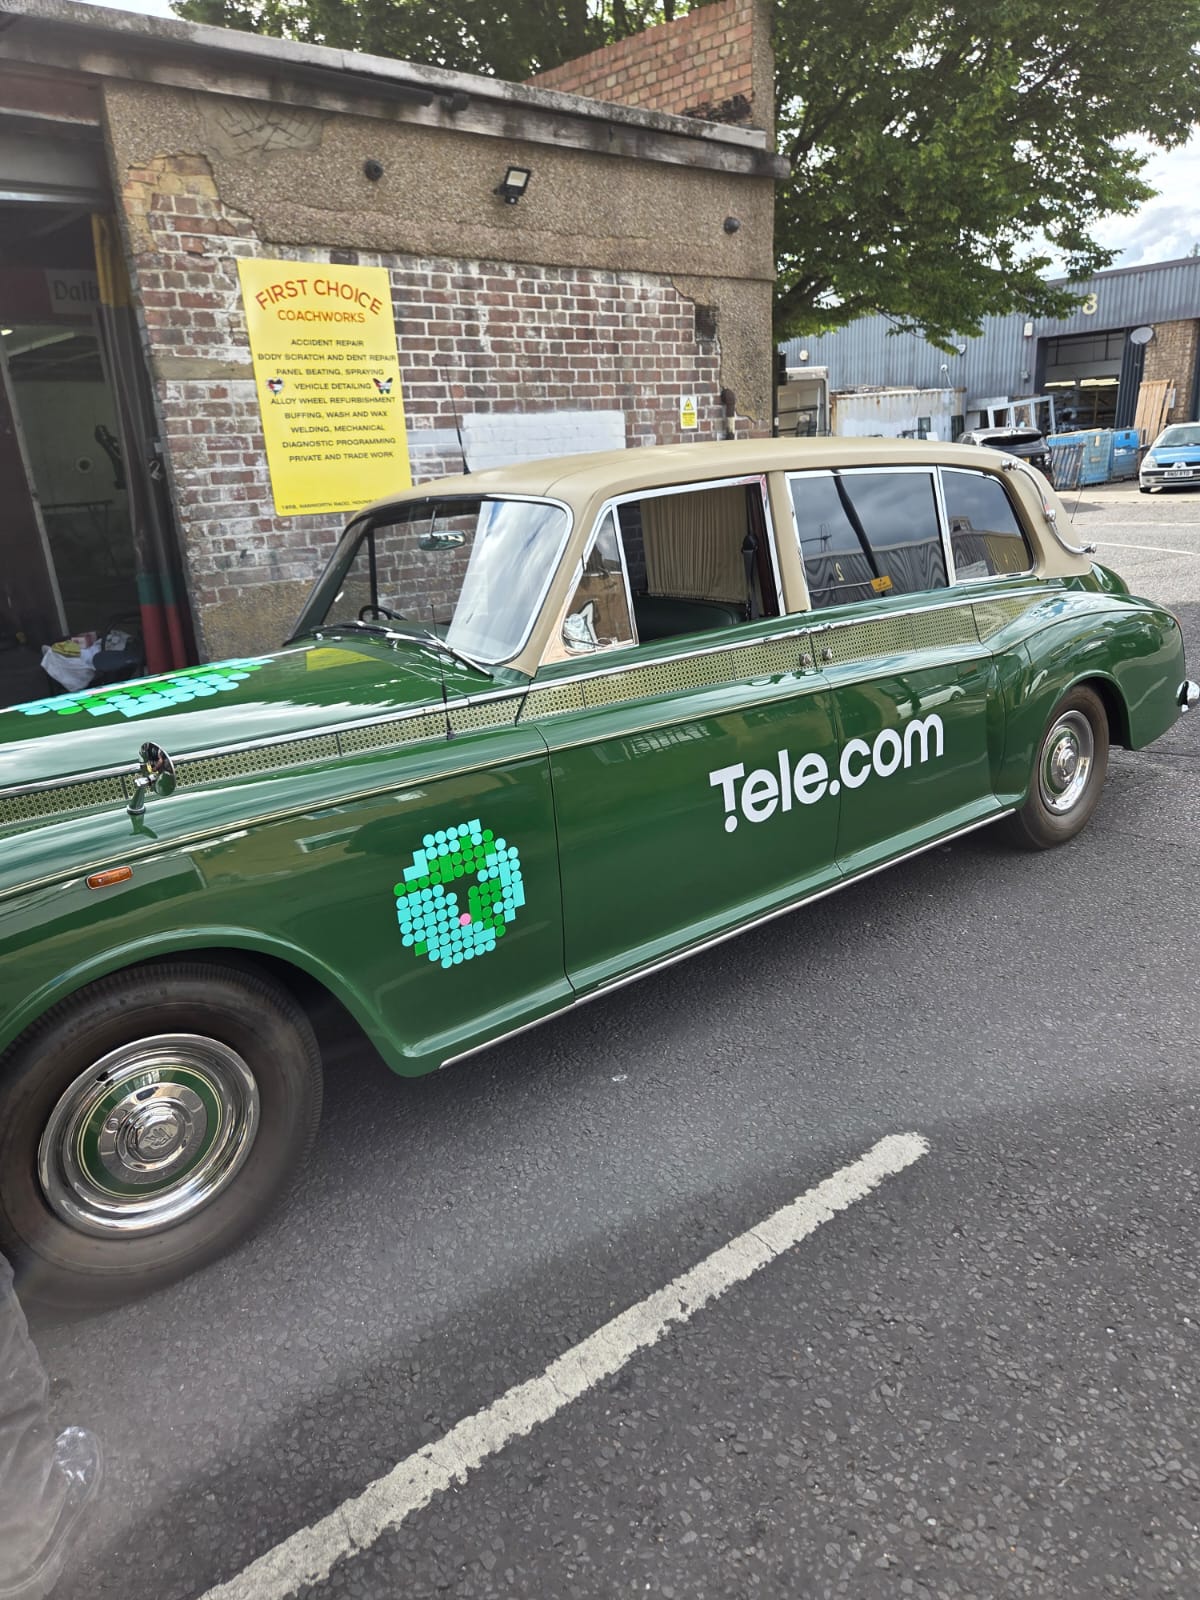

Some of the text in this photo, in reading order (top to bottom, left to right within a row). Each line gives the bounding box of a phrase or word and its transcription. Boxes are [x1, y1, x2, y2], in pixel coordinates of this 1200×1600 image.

[255, 279, 383, 315] FIRST CHOICE
[277, 309, 366, 323] COACHWORKS
[284, 353, 325, 361] SCRATCH
[305, 368, 343, 376] BEATING,
[282, 437, 396, 448] DIAGNOSTIC PROGRAMMING
[289, 454, 322, 462] PRIVATE
[709, 714, 944, 832] Tele.com
